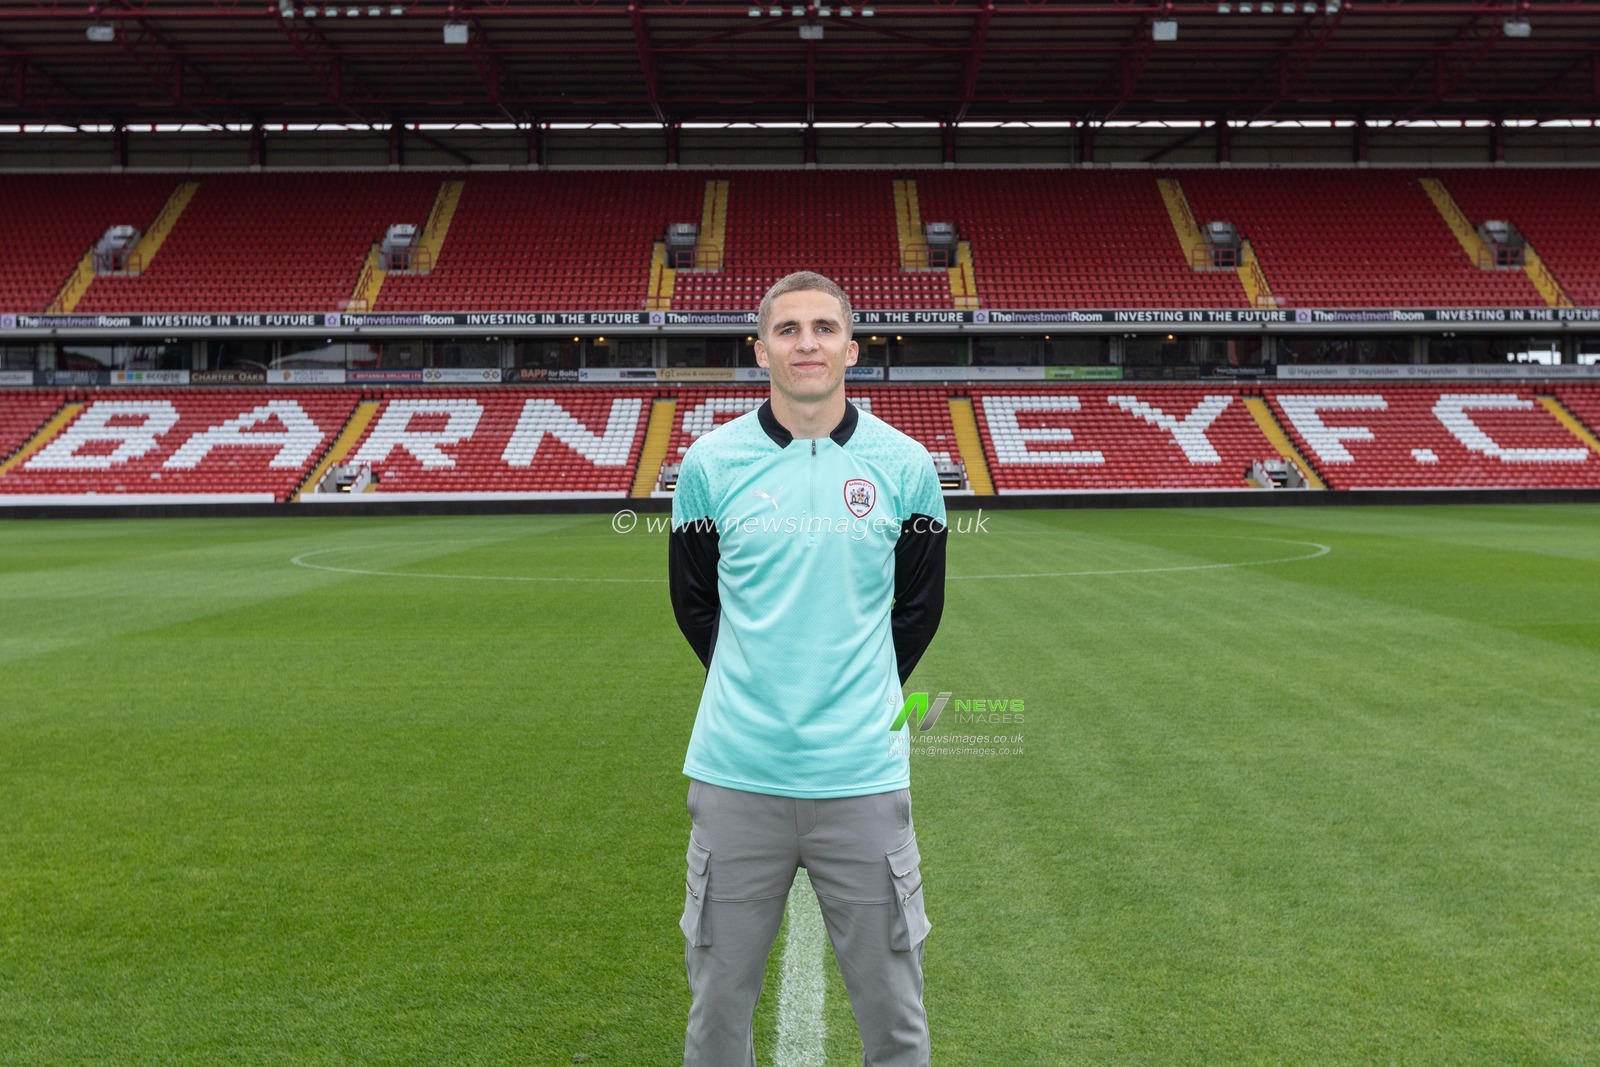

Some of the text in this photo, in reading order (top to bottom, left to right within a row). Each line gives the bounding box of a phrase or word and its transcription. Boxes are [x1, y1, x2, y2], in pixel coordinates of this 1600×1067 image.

[142, 315, 211, 326] INVESTING
[217, 315, 231, 326] IN
[235, 315, 260, 326] THE
[266, 314, 315, 326] FUTURE
[342, 314, 454, 326] TheInvestmentRoom
[467, 314, 536, 325] INVESTING
[542, 314, 555, 324] IN
[560, 314, 585, 324] THE
[590, 313, 639, 324] FUTURE
[865, 312, 879, 322] IN
[884, 312, 909, 322] THE
[915, 312, 964, 322] FUTURE
[991, 312, 1102, 322] TheInvestmentRoom
[1115, 311, 1183, 322] INVESTING
[1189, 311, 1203, 321] IN
[1208, 311, 1232, 321] THE
[1237, 311, 1286, 321] FUTURE
[1314, 310, 1424, 321] TheInvestmentRoom
[1436, 310, 1505, 320] INVESTING
[1510, 310, 1524, 320] IN
[1529, 310, 1554, 320] THE
[1558, 309, 1600, 320] FUTUR
[521, 369, 547, 377] BAPP
